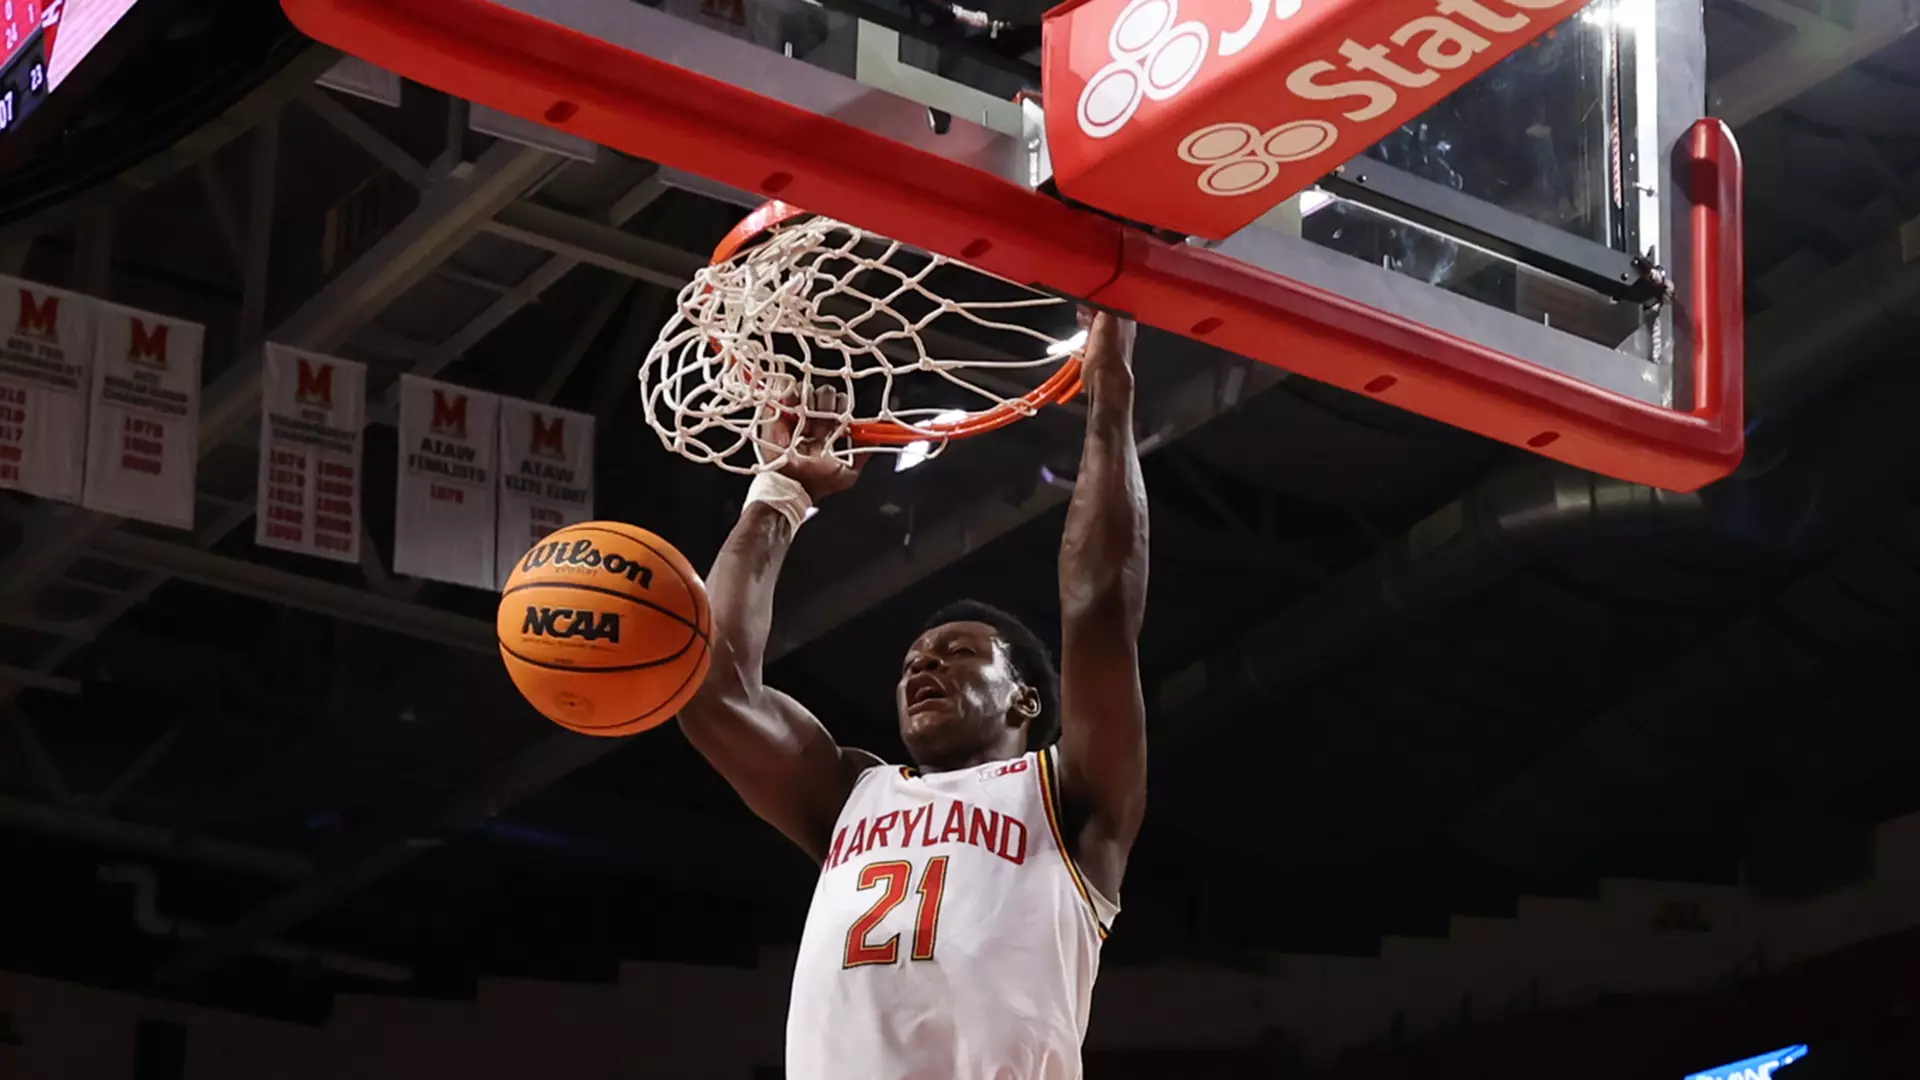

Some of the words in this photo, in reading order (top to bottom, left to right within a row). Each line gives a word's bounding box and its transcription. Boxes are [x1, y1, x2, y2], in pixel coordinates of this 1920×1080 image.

[1286, 0, 1564, 122] Stat
[18, 289, 60, 343] M
[128, 316, 170, 370] M
[296, 357, 333, 410] M
[430, 390, 468, 440] M
[530, 411, 566, 462] M
[521, 538, 653, 590] Wilson
[521, 606, 620, 644] NCAA
[824, 799, 1028, 873] MARYLAND
[842, 855, 950, 970] 21
